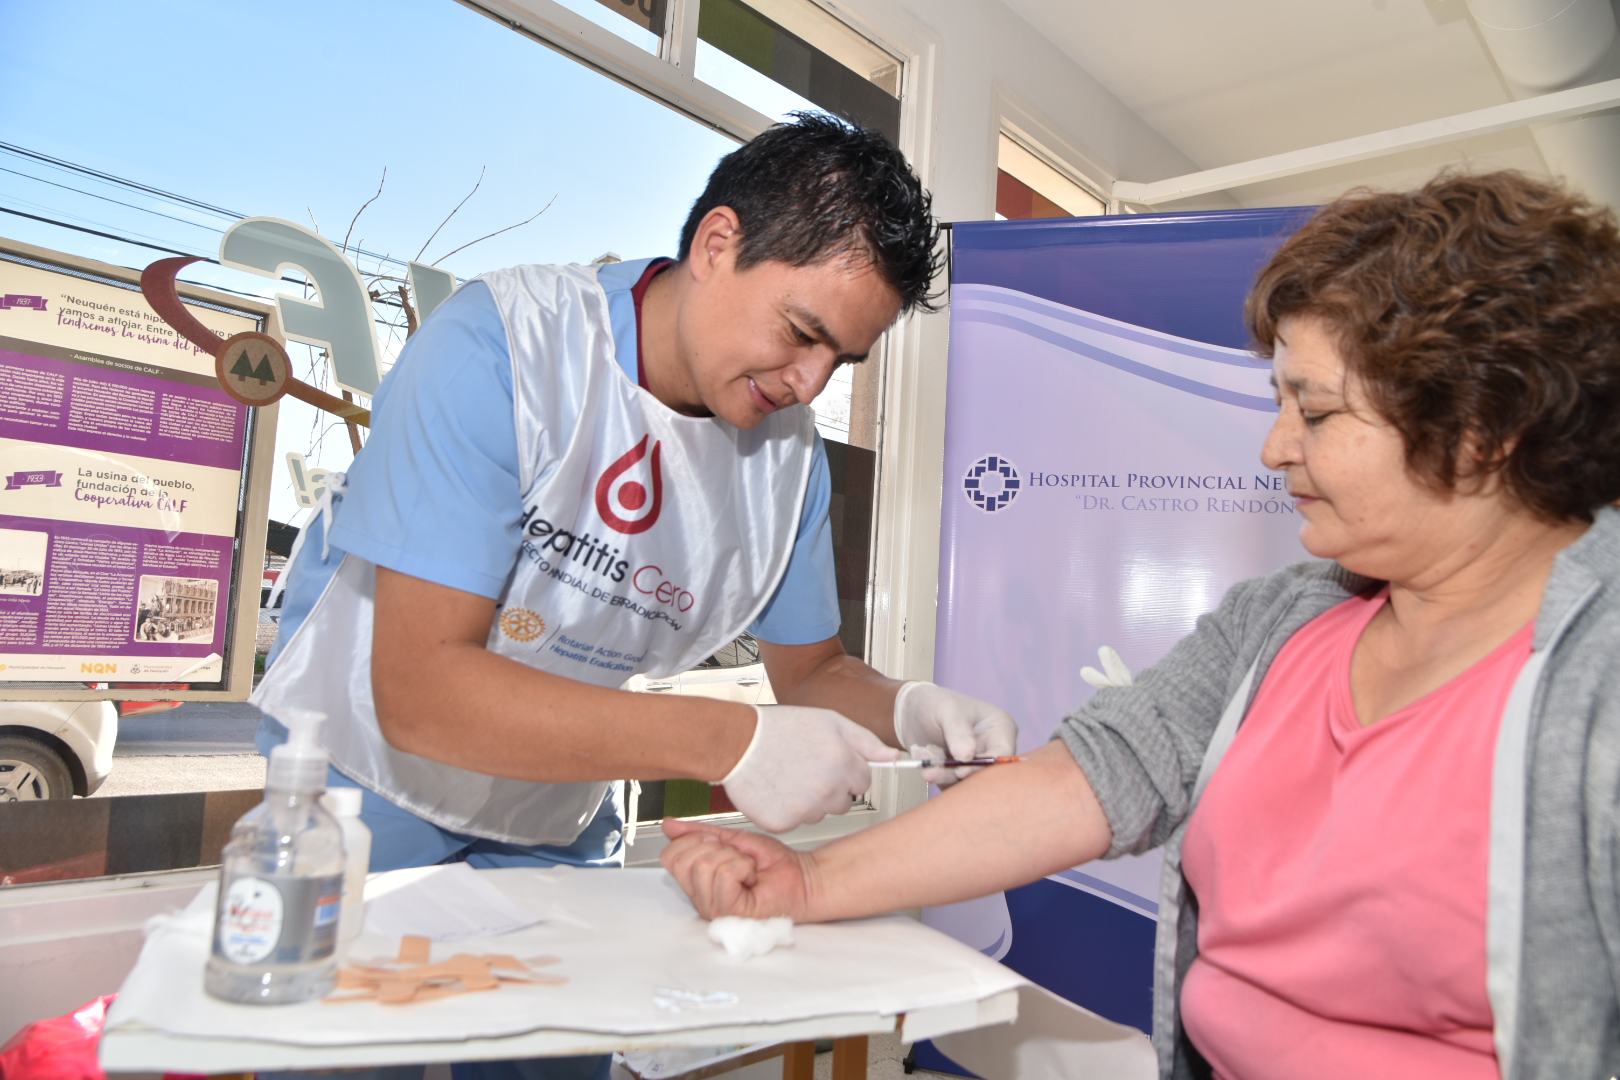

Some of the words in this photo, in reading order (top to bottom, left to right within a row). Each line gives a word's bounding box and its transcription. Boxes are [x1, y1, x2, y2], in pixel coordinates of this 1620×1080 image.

[60, 306, 95, 320] vamos
[108, 316, 143, 330] aflojar.
[146, 324, 173, 336] Entre
[118, 308, 140, 318] está
[122, 326, 135, 338] la
[138, 334, 170, 346] usina
[173, 338, 190, 350] del
[74, 353, 104, 364] Asamblea
[26, 474, 44, 483] 1933
[77, 479, 137, 494] fundación
[141, 488, 155, 496] de
[159, 489, 168, 498] la
[78, 468, 92, 477] La
[96, 471, 127, 482] usina
[131, 475, 149, 484] del
[153, 478, 195, 492] pueblo,
[75, 487, 154, 508] Cooperativa
[157, 497, 188, 513] CALF
[591, 587, 610, 602] DE
[633, 565, 694, 612] Cero
[549, 644, 588, 662] Hepatitis
[589, 657, 634, 672] Eradication
[558, 635, 594, 651] Rotarian
[595, 647, 622, 658] Action
[81, 663, 117, 674] NQN
